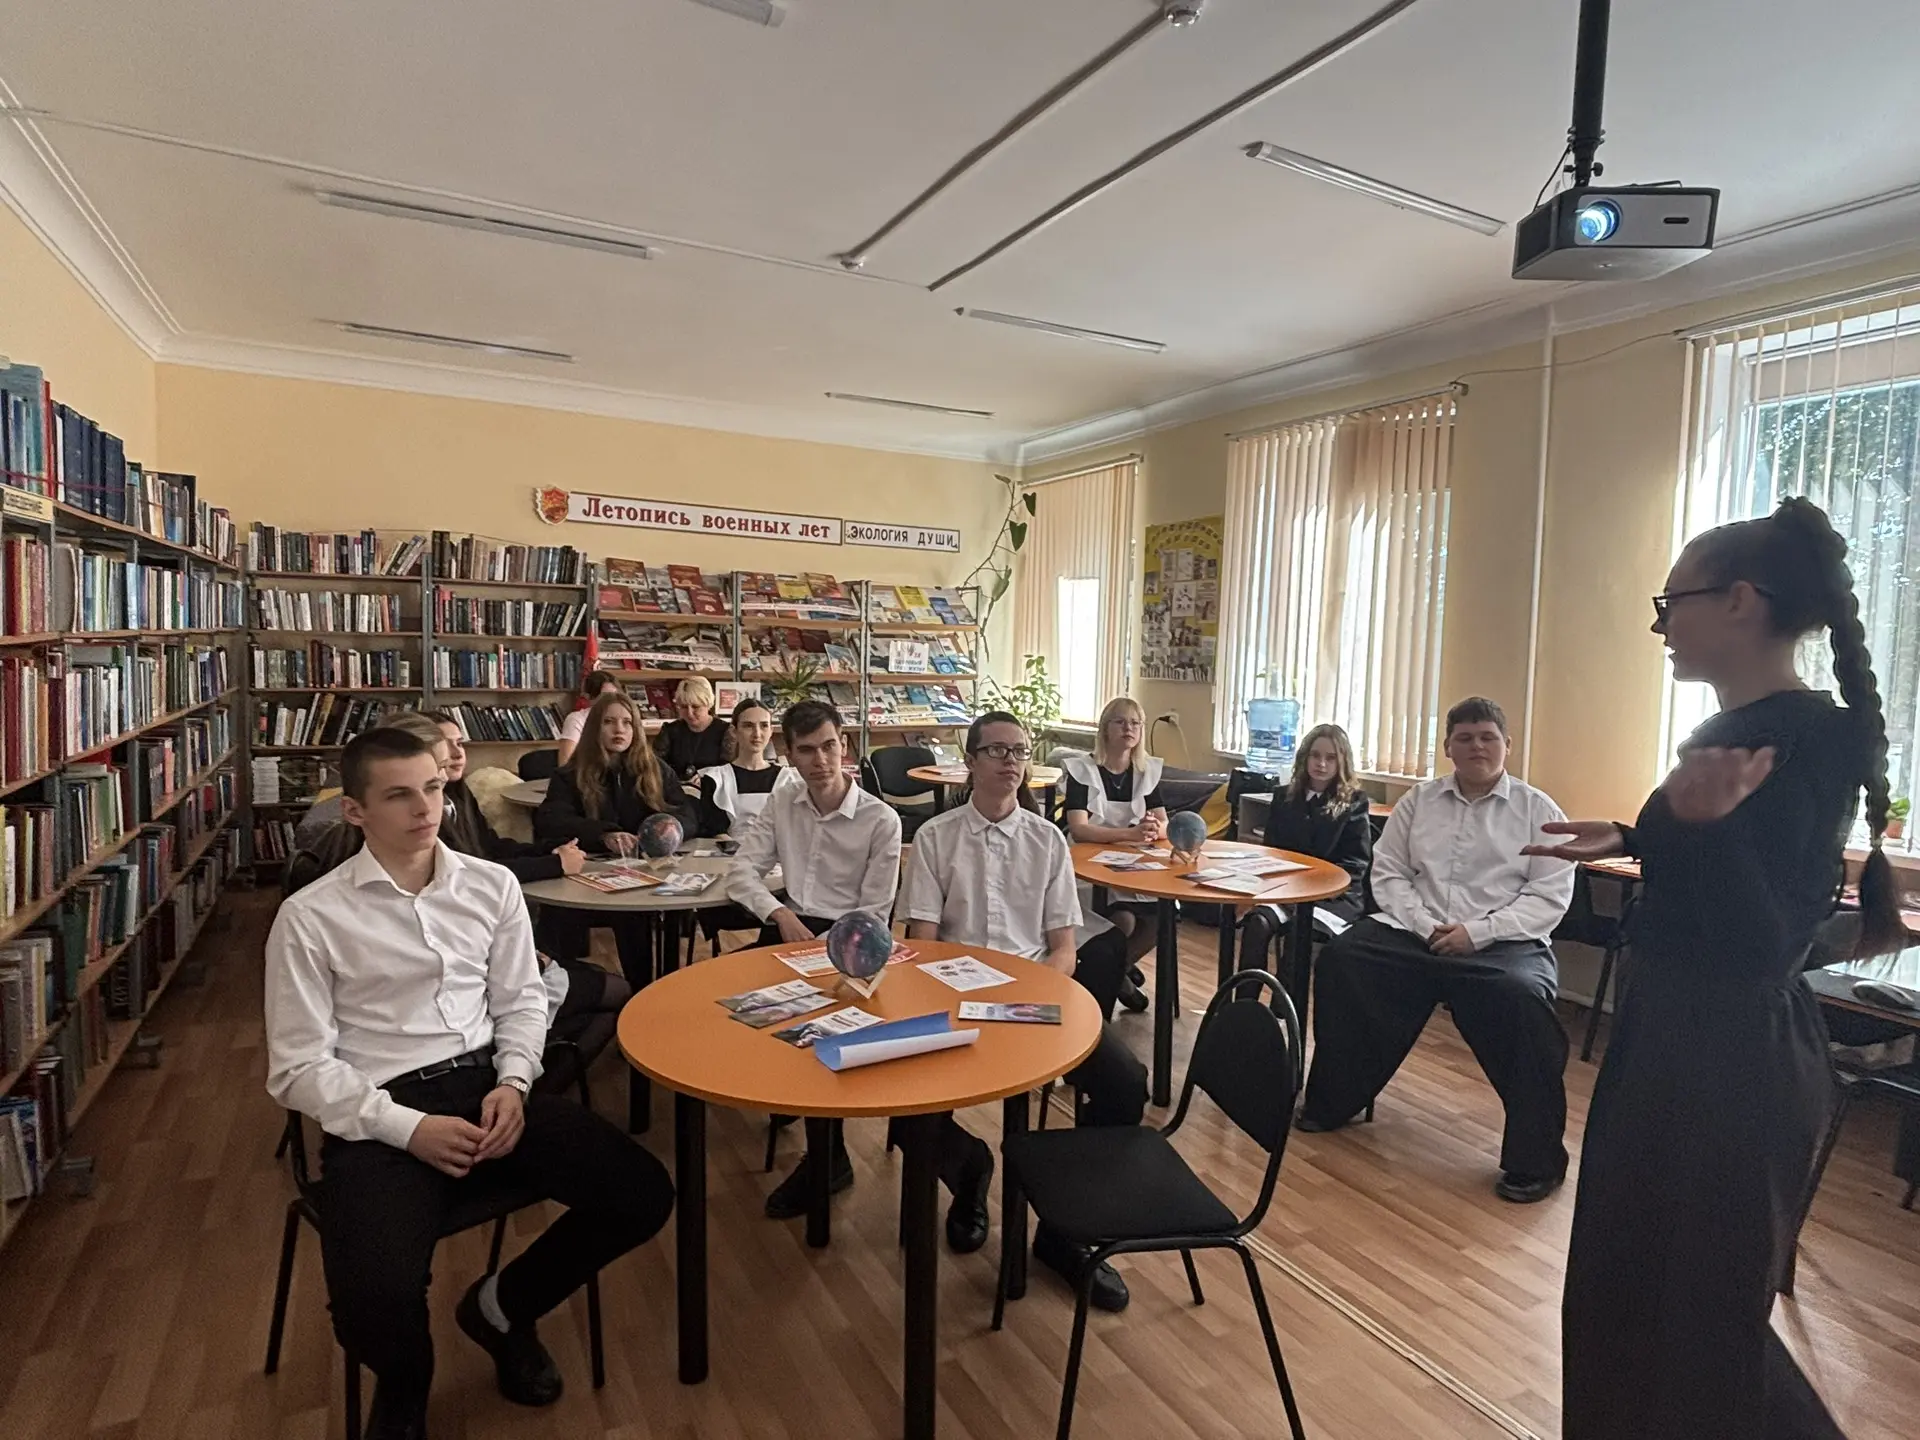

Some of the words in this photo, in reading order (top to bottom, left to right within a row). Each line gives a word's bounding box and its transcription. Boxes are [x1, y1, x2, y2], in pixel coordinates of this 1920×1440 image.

[582, 497, 691, 526] Летопись
[702, 514, 791, 535] военных
[798, 523, 830, 538] лет
[850, 525, 909, 542] ЭКОЛОГИЯ
[917, 531, 953, 547] ДУШИ
